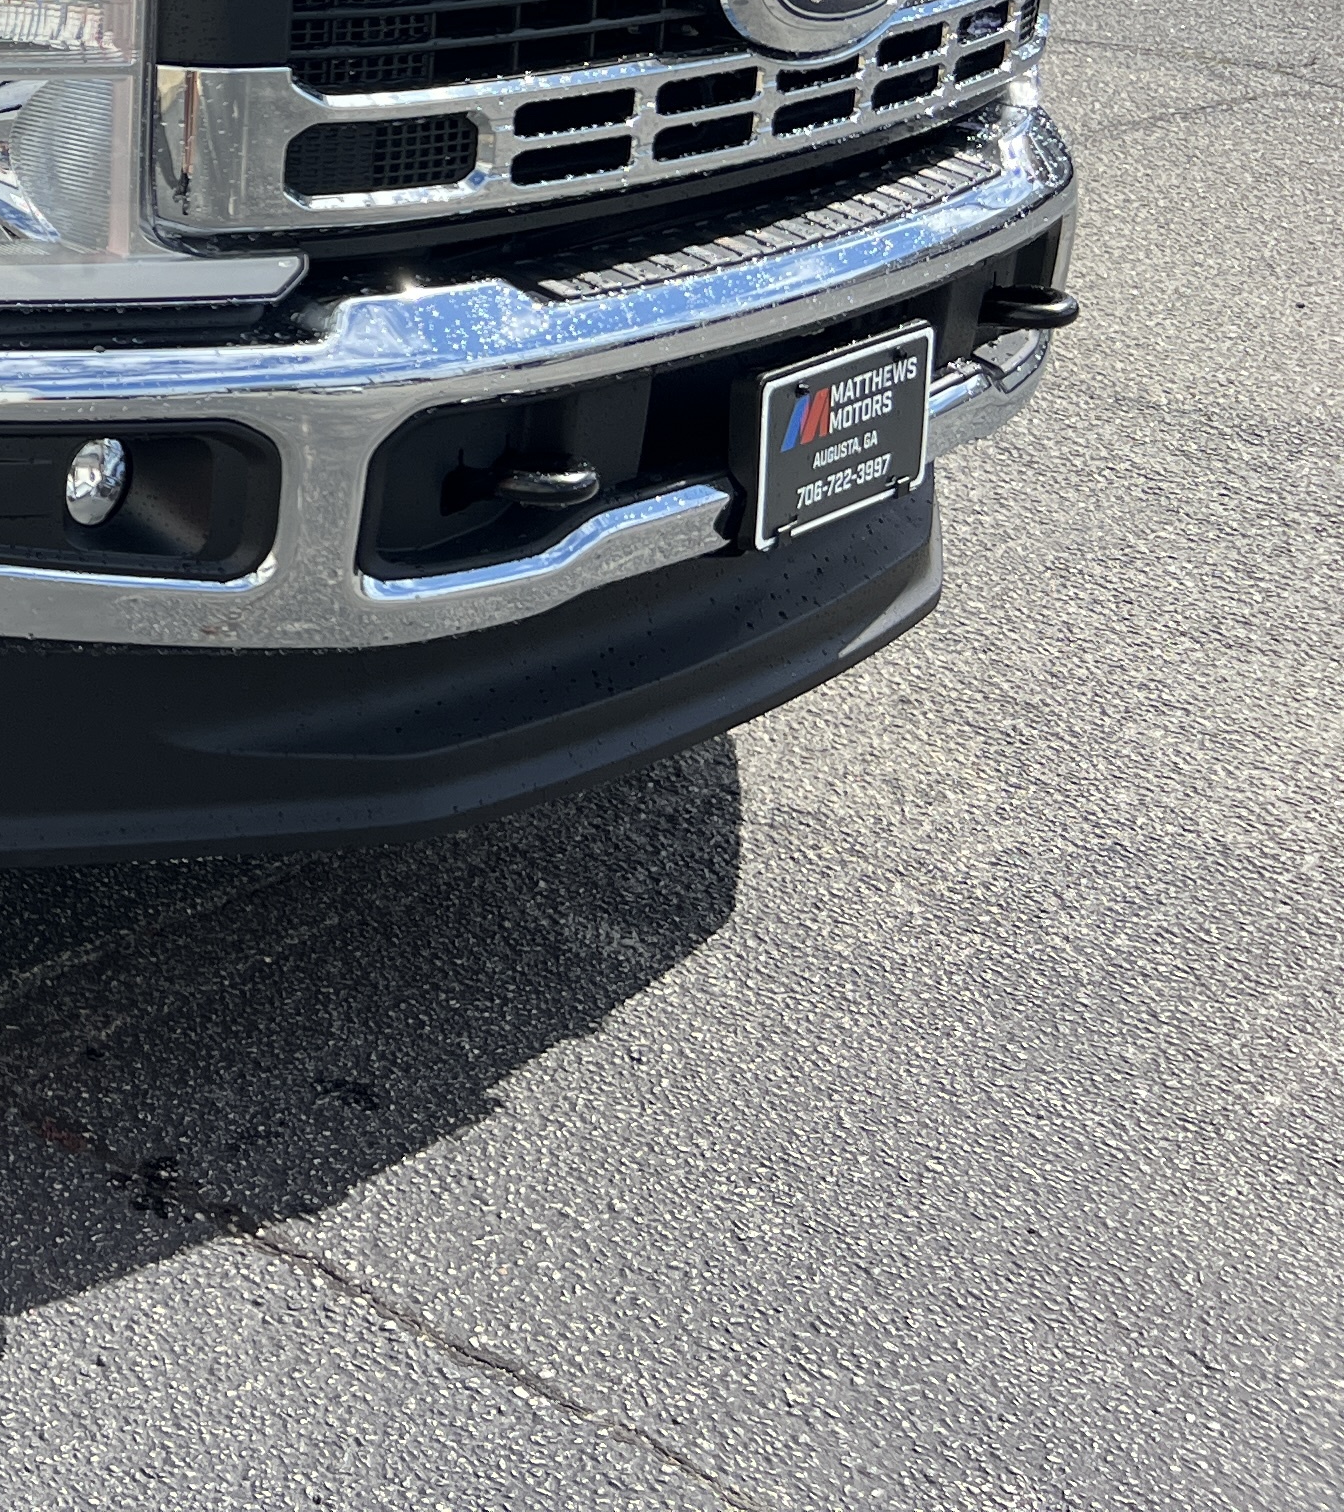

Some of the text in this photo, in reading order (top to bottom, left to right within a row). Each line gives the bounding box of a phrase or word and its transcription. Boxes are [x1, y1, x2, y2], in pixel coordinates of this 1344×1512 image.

[830, 356, 918, 406] MATTHEWS
[828, 392, 893, 434] MOTORS
[812, 430, 878, 470] AUGUSTA, GA
[796, 453, 892, 510] 706-722-3997
